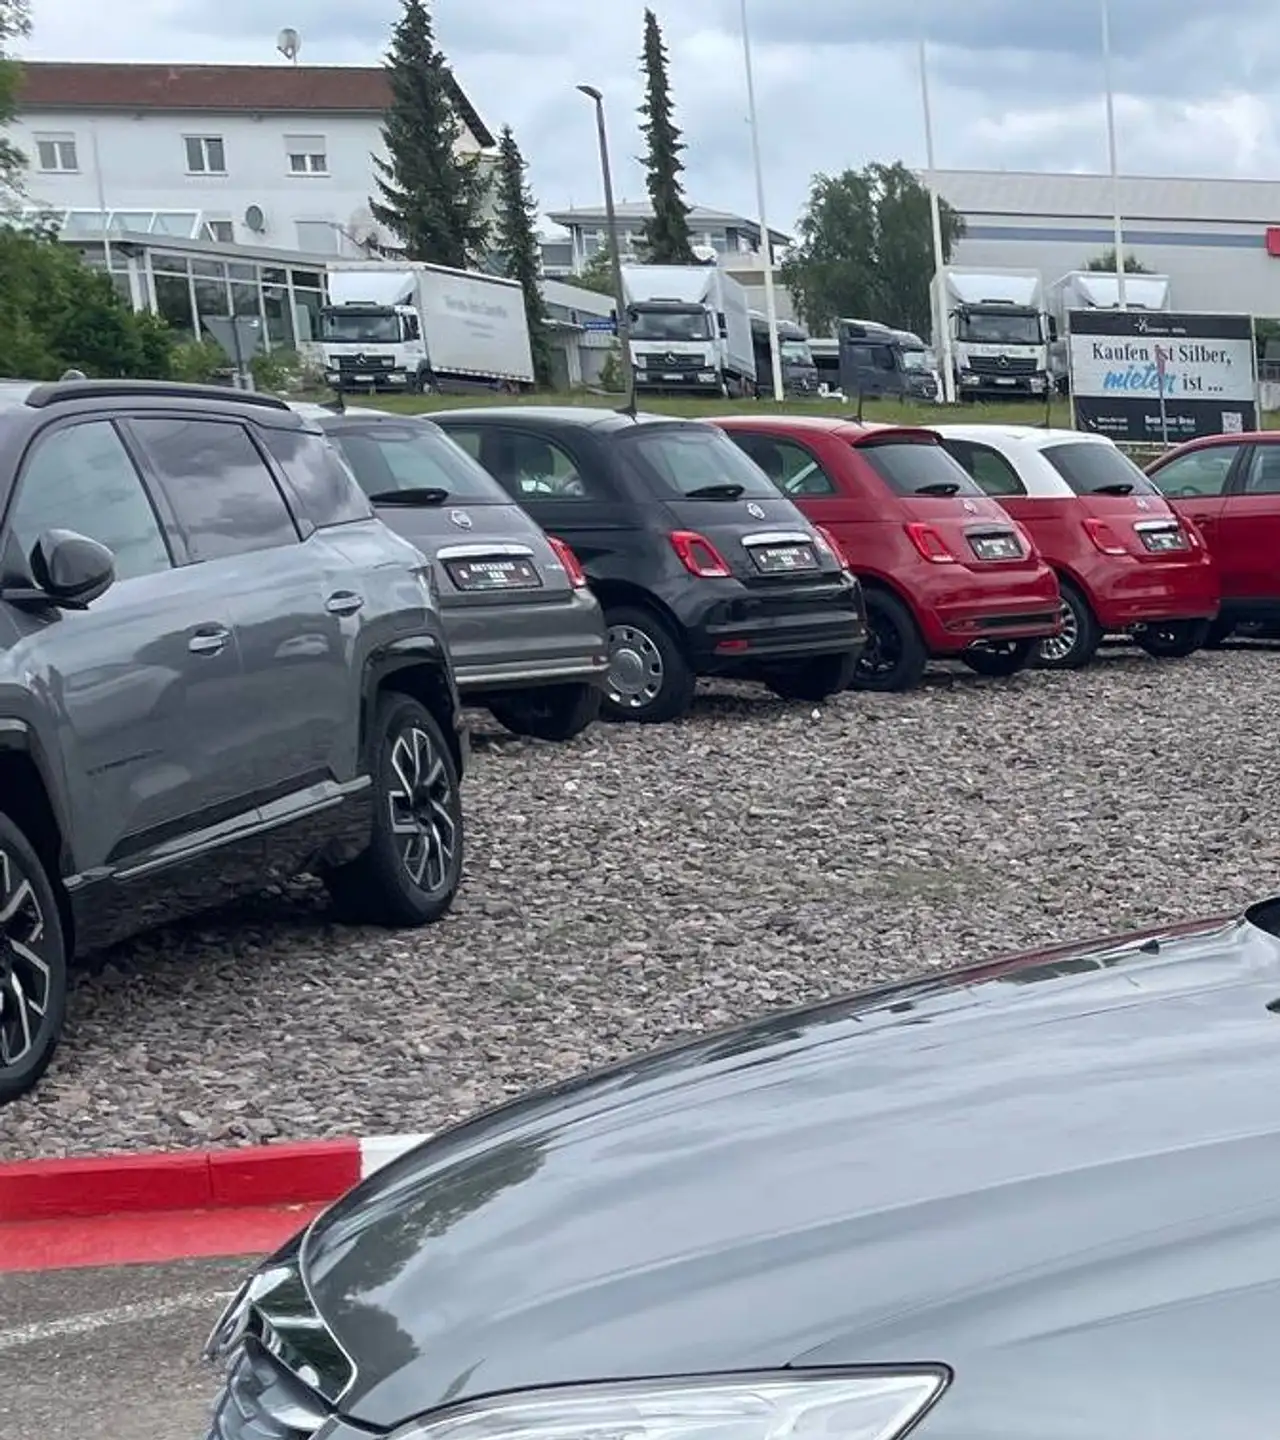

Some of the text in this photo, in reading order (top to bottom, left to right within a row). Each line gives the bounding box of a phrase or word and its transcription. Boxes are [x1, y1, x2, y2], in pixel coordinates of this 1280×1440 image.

[1092, 342, 1149, 361] Kaufen
[1178, 345, 1232, 365] Silber,
[1183, 373, 1203, 392] ist
